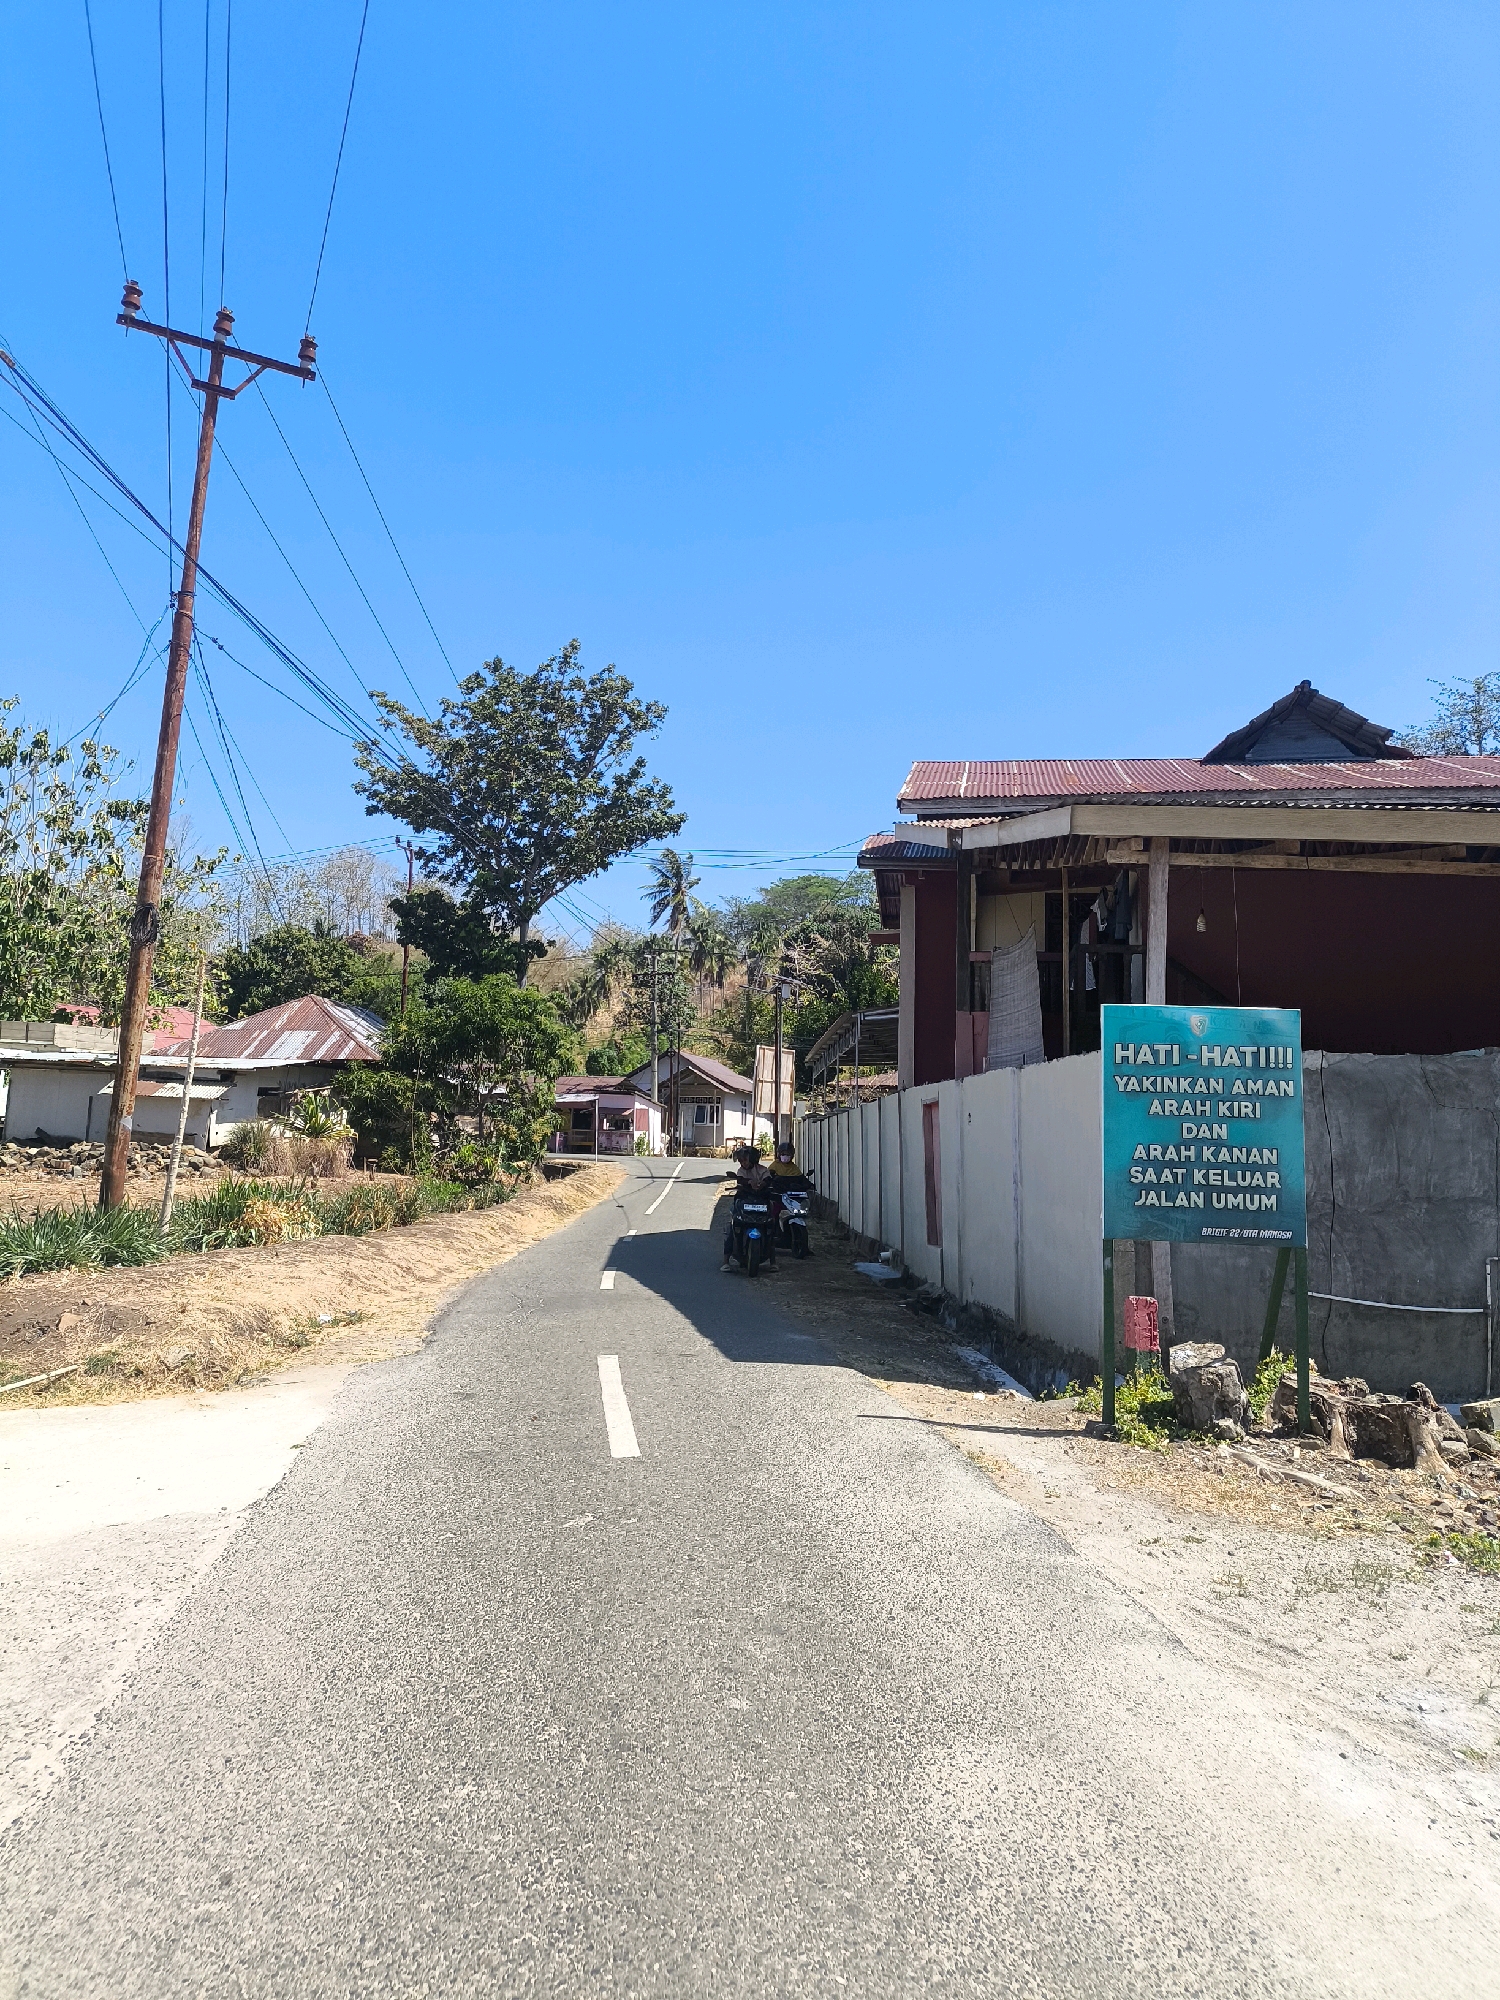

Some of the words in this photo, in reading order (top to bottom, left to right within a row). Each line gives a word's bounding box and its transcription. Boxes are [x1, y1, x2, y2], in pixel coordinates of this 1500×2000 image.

[1114, 1043, 1180, 1065] HATI
[1114, 1075, 1224, 1094] YAKINKAN
[1231, 1079, 1295, 1097] AMAN
[1149, 1099, 1211, 1117] ARAH
[1218, 1102, 1261, 1118] KIRI
[1182, 1122, 1228, 1140] DAN
[1133, 1145, 1195, 1161] ARAH
[1202, 1147, 1278, 1165] KANAN
[1129, 1167, 1187, 1184] SAAT
[1193, 1169, 1281, 1188] KELUAR
[1134, 1190, 1204, 1208] JALAN
[1212, 1192, 1277, 1211] UMUM
[1202, 1228, 1228, 1237] BRIGIF
